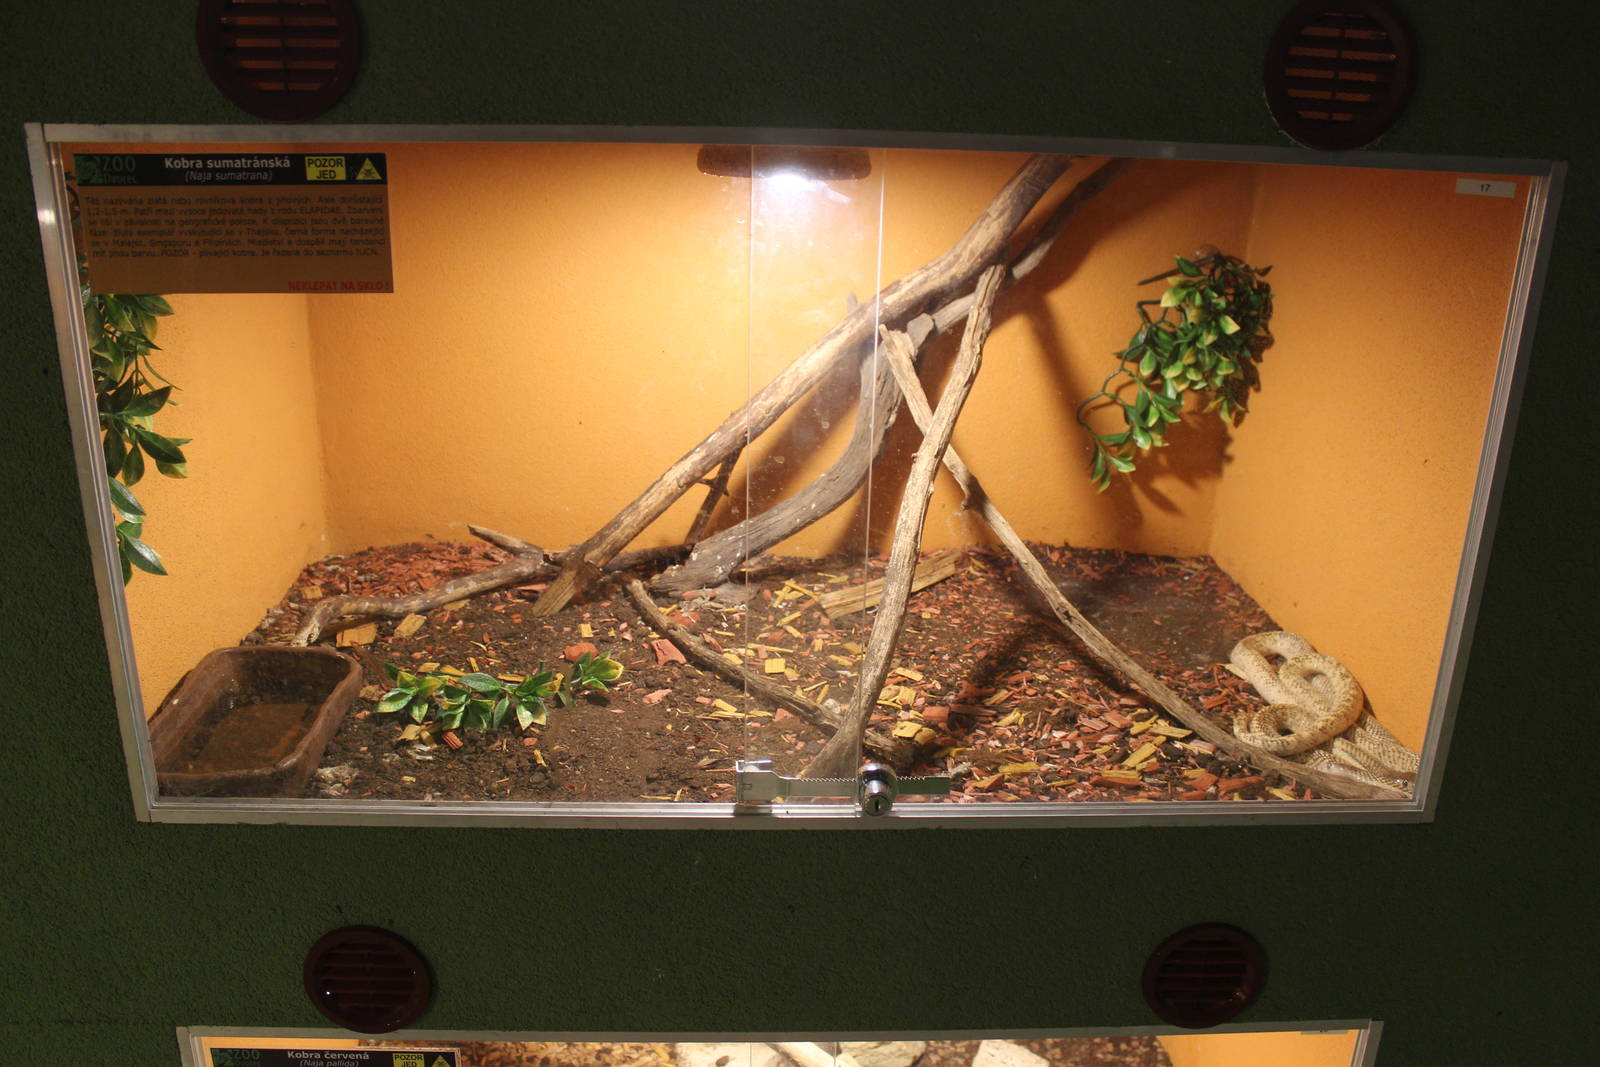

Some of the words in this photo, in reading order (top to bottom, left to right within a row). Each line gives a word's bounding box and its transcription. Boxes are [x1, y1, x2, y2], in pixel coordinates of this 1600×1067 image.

[102, 155, 136, 172] ZOO
[164, 157, 203, 169] Kobra
[206, 156, 291, 169] sumatránská
[307, 158, 344, 168] POZOR
[184, 170, 212, 183] (Naja
[215, 170, 273, 183] sumatrana)
[316, 169, 337, 180] JED
[1480, 184, 1490, 192] 17
[287, 1050, 321, 1060] Kobra
[323, 1050, 370, 1061] červená
[394, 1053, 424, 1061] POZOR
